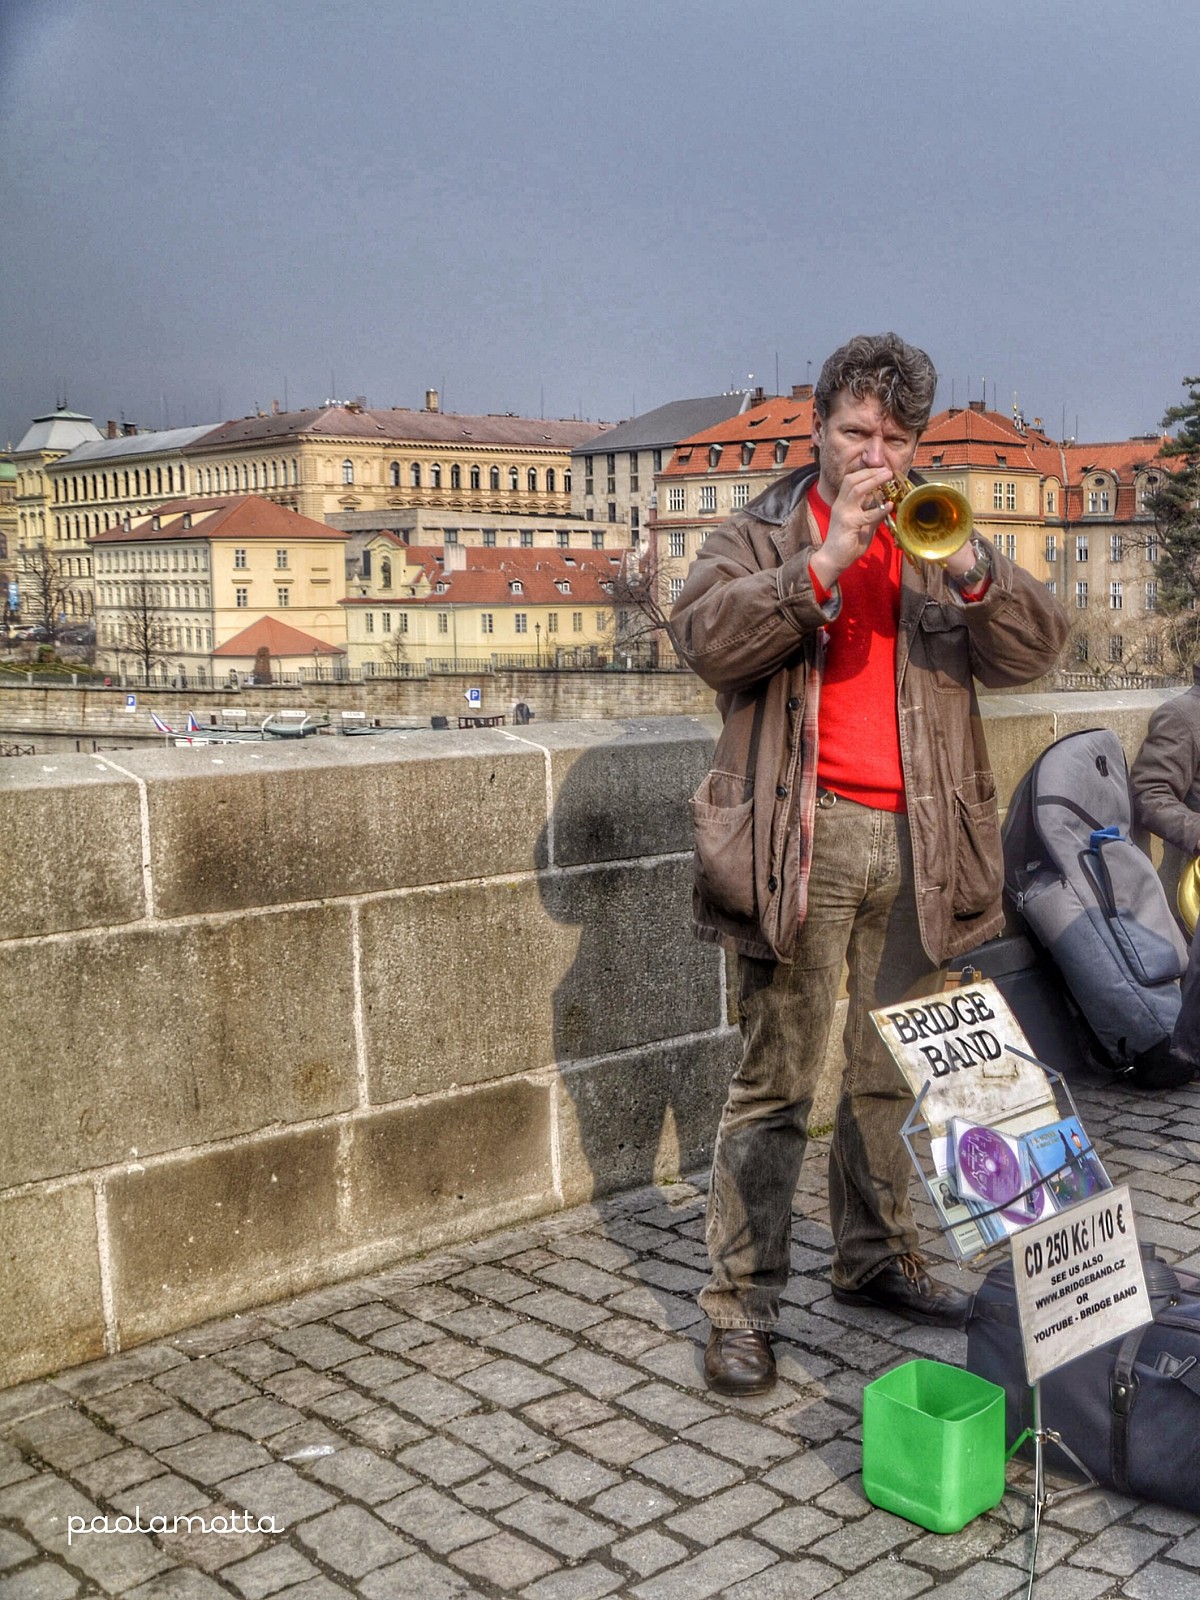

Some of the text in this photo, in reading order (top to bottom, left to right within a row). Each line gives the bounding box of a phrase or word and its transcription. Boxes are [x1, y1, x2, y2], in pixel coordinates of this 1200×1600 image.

[886, 991, 995, 1045] BRIDGE
[919, 1030, 1002, 1078] BAND
[1025, 1242, 1043, 1279] CD
[1046, 1229, 1069, 1269] 250
[1071, 1219, 1089, 1256] Kč
[1099, 1209, 1114, 1242] 10
[1116, 1203, 1126, 1234] €
[1035, 1259, 1126, 1310] WWW.BRIDGEBAND.CZ
[1051, 1254, 1104, 1286] SEE US ALSO
[1033, 1316, 1074, 1343] YOUTUBE
[1080, 1297, 1112, 1321] BRIDGE
[1113, 1285, 1138, 1304] BAND
[1076, 1293, 1089, 1305] OR
